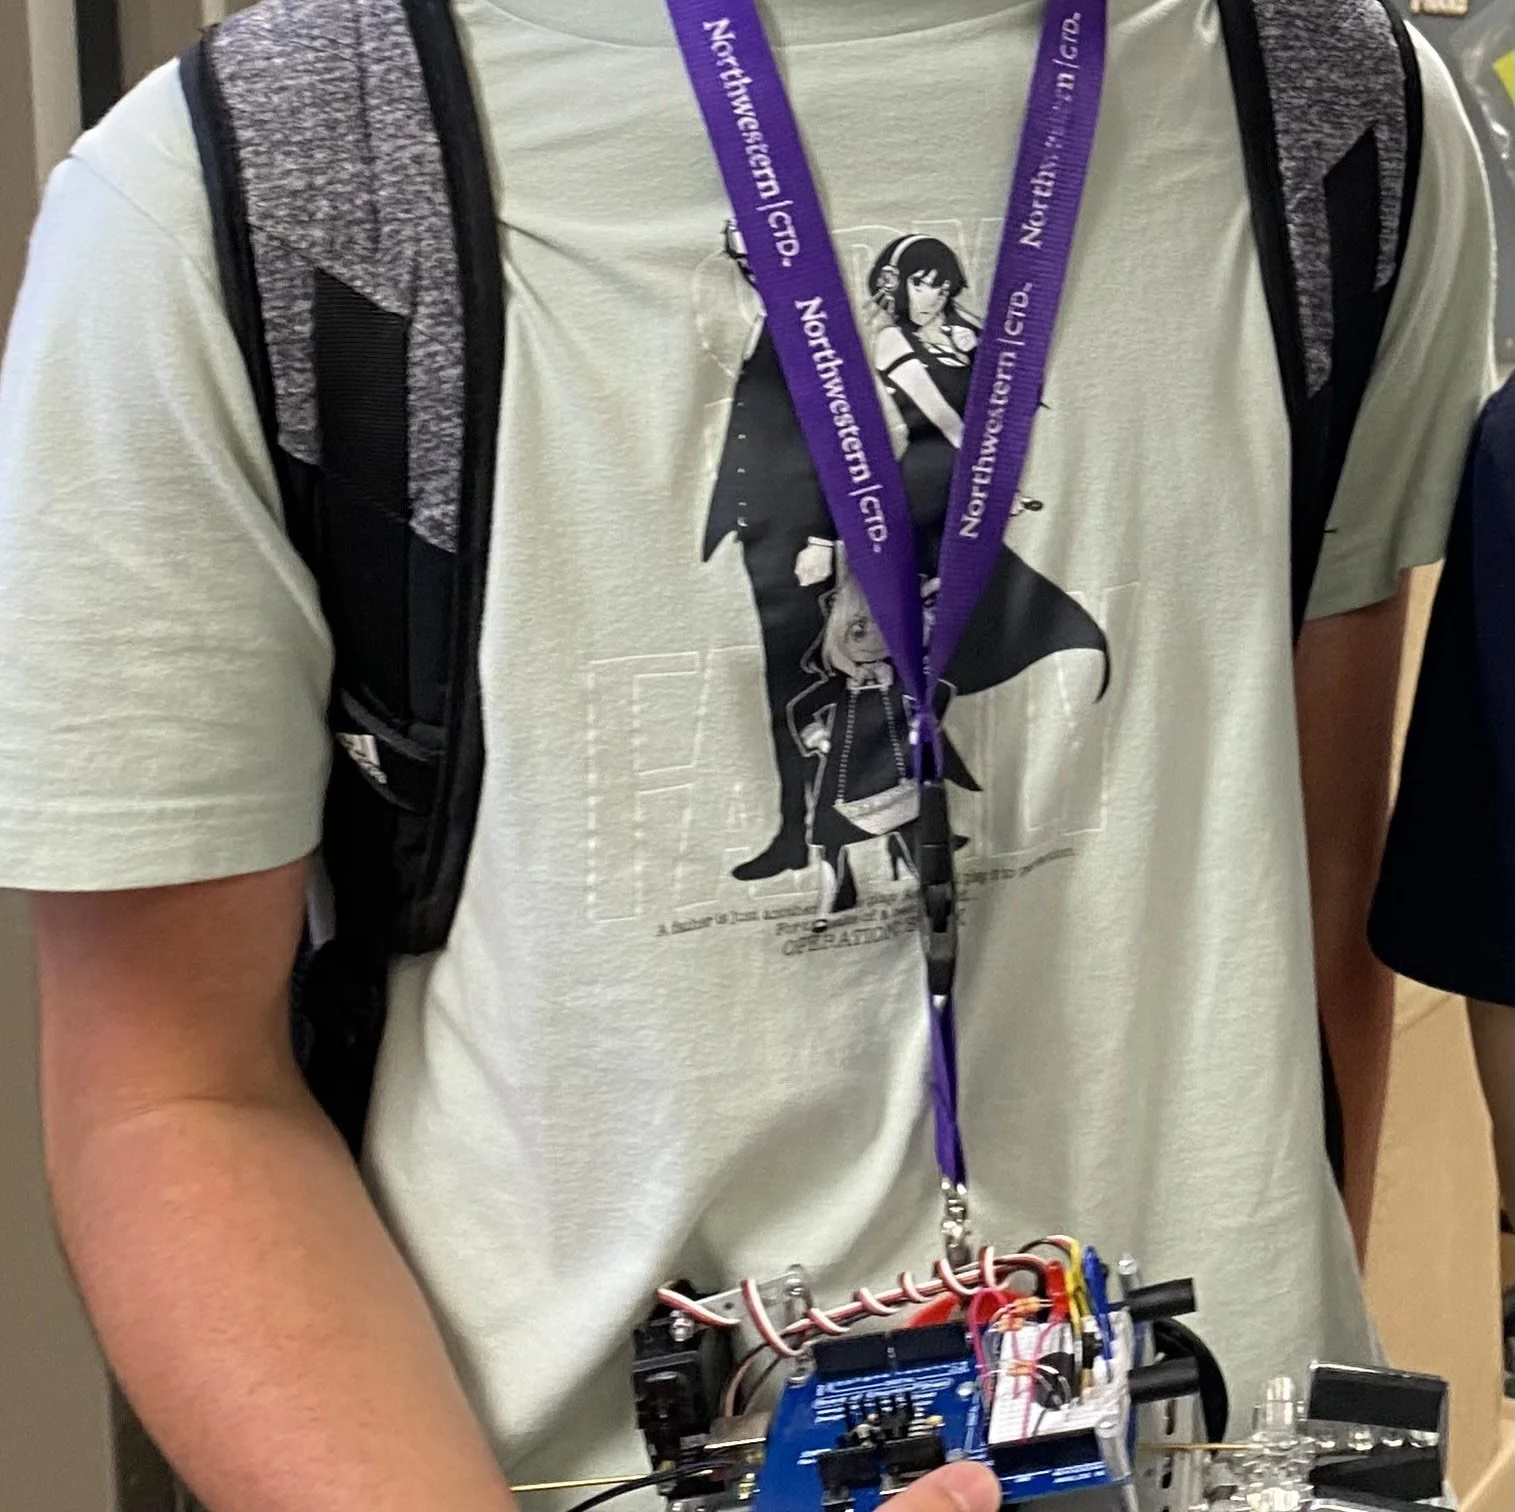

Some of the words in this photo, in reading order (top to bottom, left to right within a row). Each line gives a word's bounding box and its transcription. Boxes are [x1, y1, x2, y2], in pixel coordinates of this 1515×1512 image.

[703, 17, 780, 199] Northwestern
[794, 296, 872, 484] Northwestern
[959, 351, 1018, 539] Northwestern
